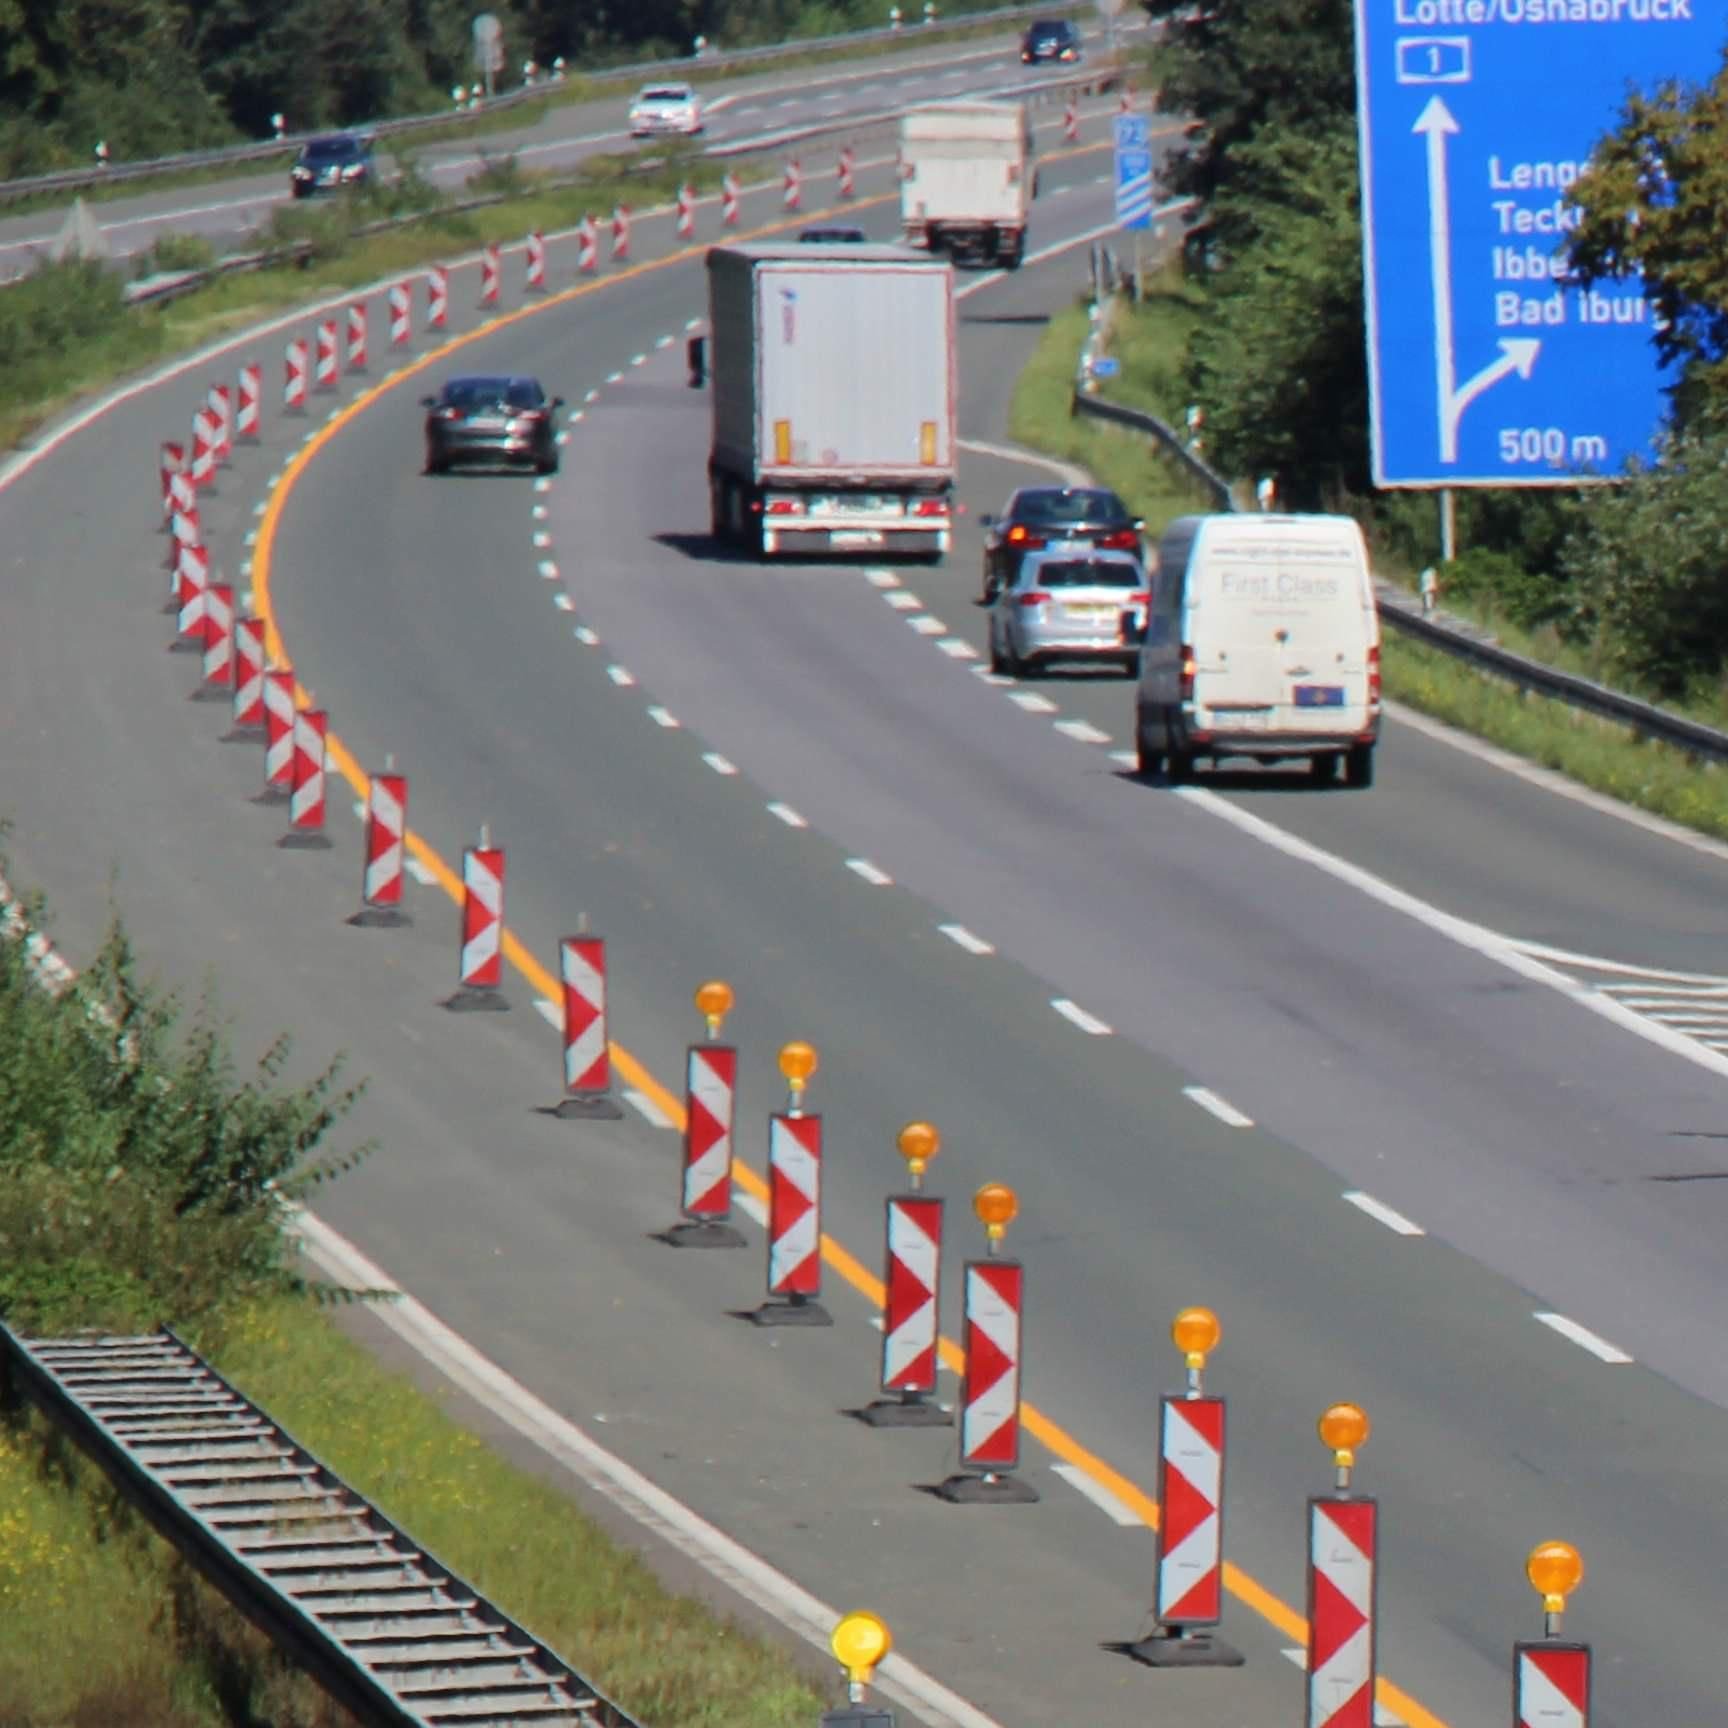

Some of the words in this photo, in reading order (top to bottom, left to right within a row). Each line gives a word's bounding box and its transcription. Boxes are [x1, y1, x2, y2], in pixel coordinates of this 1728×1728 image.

[1495, 290, 1565, 326] Bad
[1499, 427, 1566, 463] 500
[1571, 434, 1607, 461] m
